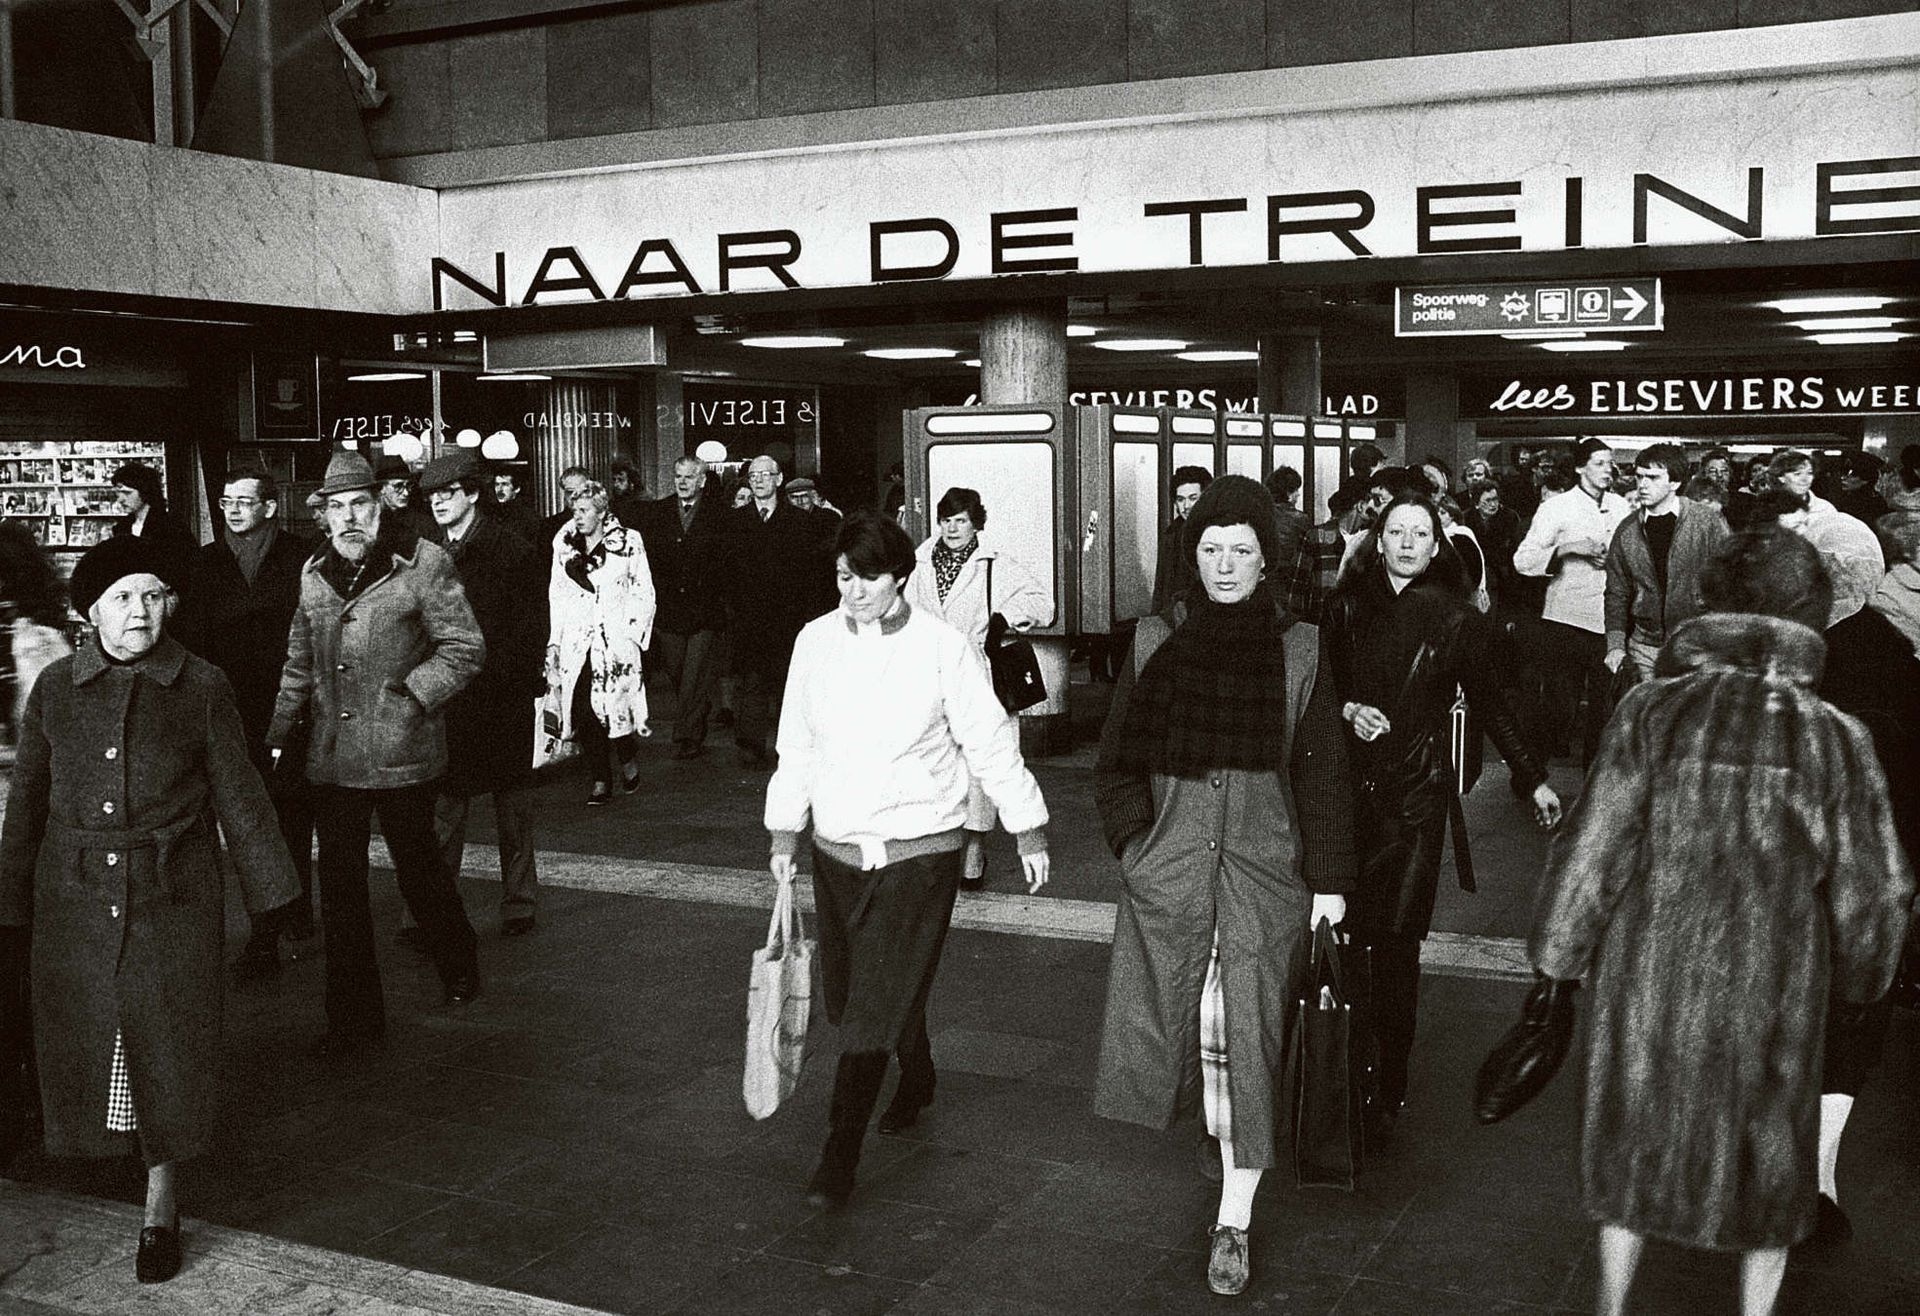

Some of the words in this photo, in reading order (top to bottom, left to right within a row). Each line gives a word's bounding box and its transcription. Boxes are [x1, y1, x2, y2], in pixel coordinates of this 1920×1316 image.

[431, 229, 802, 310] NAAR
[870, 207, 1079, 282] DE
[1144, 156, 1920, 266] TREINE
[1413, 293, 1490, 308] Spoorweg-
[1412, 307, 1456, 324] politie
[1490, 380, 1575, 411] lees
[1590, 377, 1825, 412] ELSEVIERS
[1836, 385, 1920, 408] WEE
